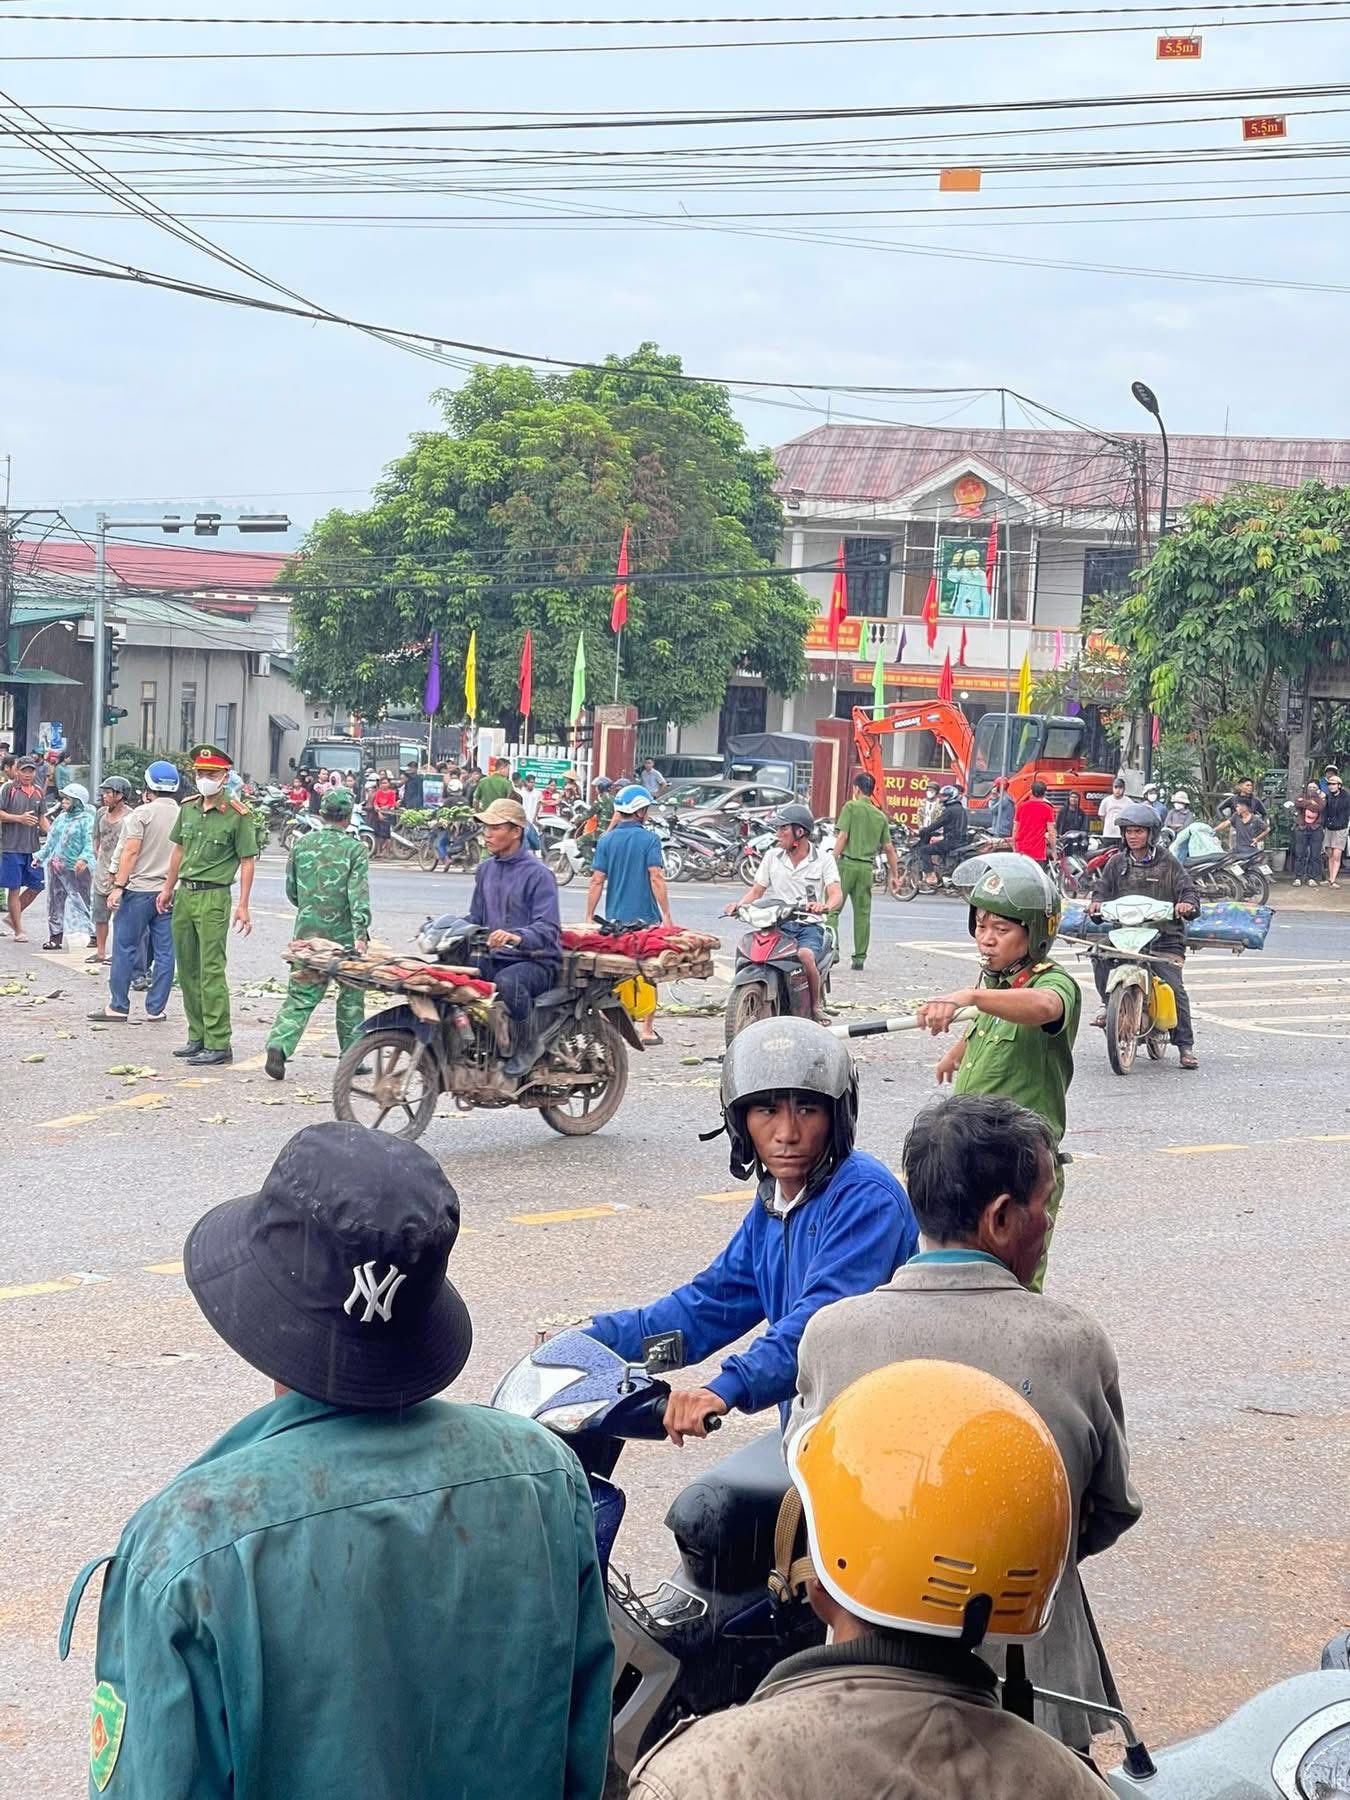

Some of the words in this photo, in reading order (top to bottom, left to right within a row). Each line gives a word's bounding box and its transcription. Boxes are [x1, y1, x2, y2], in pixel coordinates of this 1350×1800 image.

[1165, 42, 1193, 53] 5.5m
[1251, 122, 1278, 134] 5.5m
[884, 776, 906, 791] RỤ
[343, 1260, 408, 1322] NY
